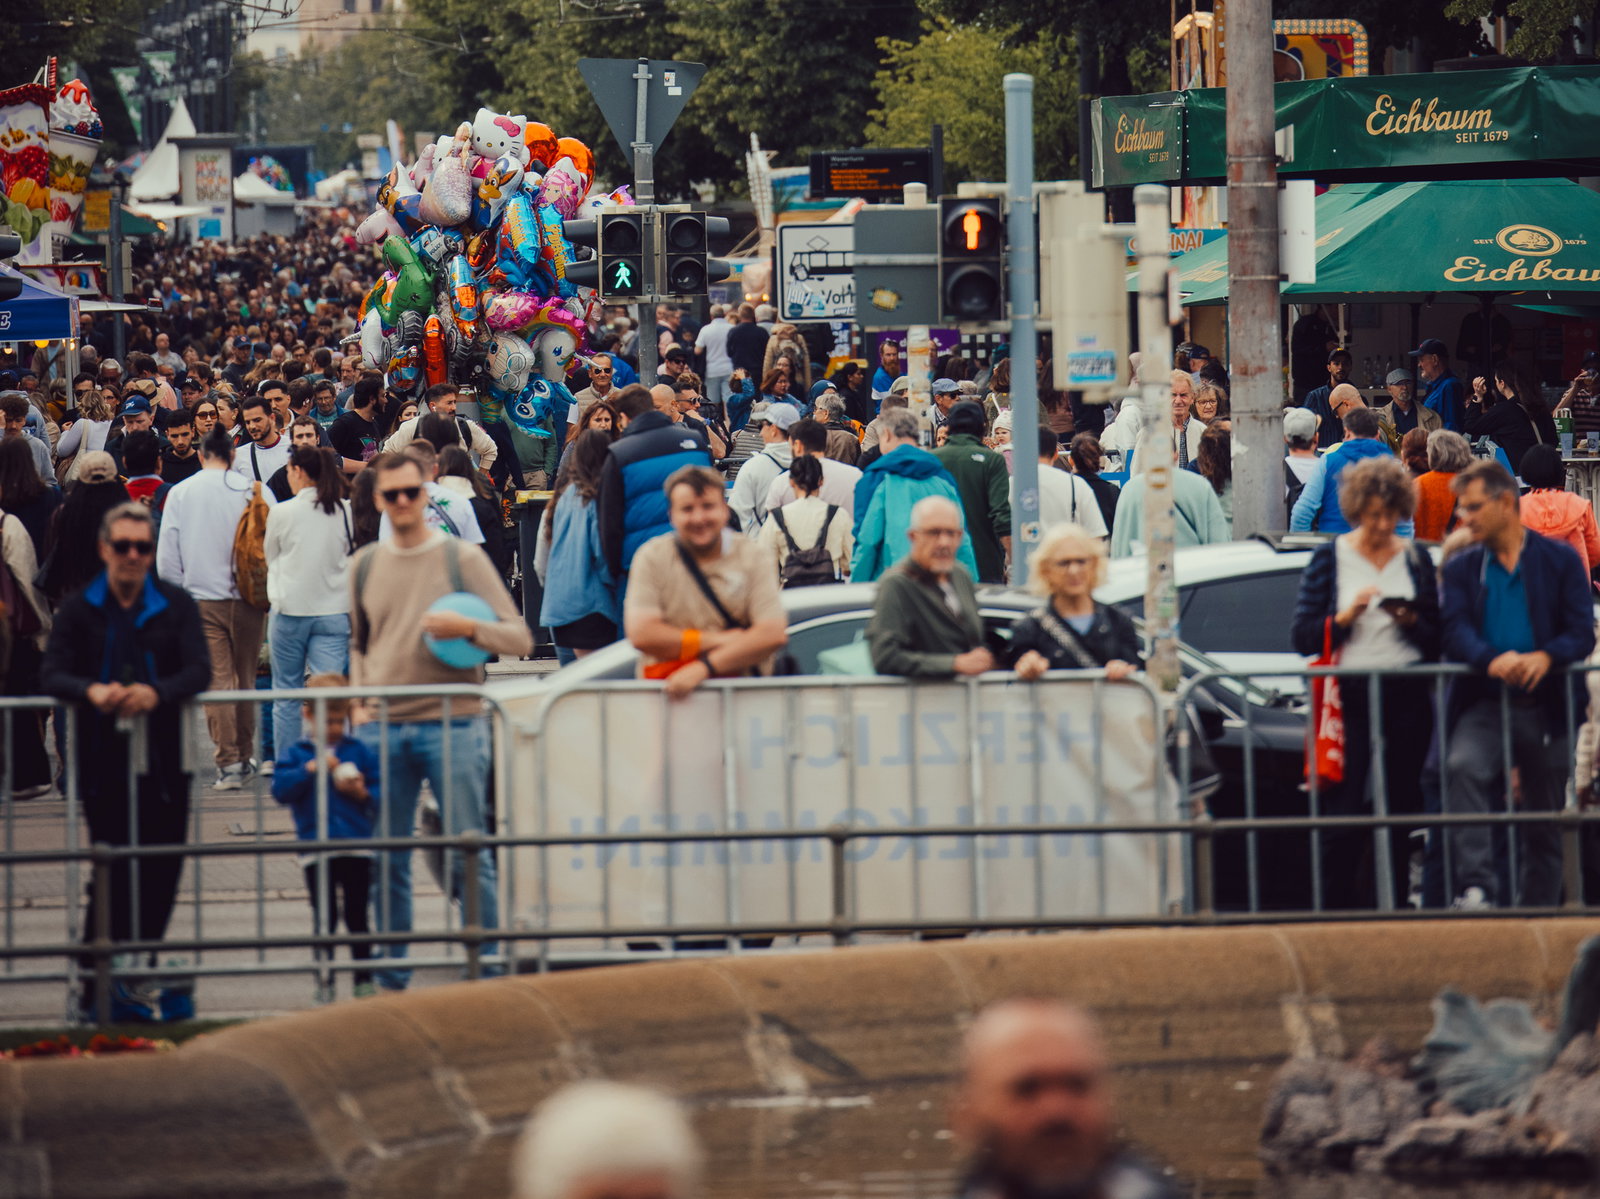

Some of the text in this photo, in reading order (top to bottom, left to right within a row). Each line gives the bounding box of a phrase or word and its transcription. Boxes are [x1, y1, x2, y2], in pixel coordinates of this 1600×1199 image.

[1366, 94, 1493, 136] Eichbaum
[1114, 113, 1165, 154] Eichbaum
[1455, 130, 1509, 143] SEIT 1679
[1148, 152, 1159, 163] SEIT
[1444, 255, 1600, 283] Eichbau
